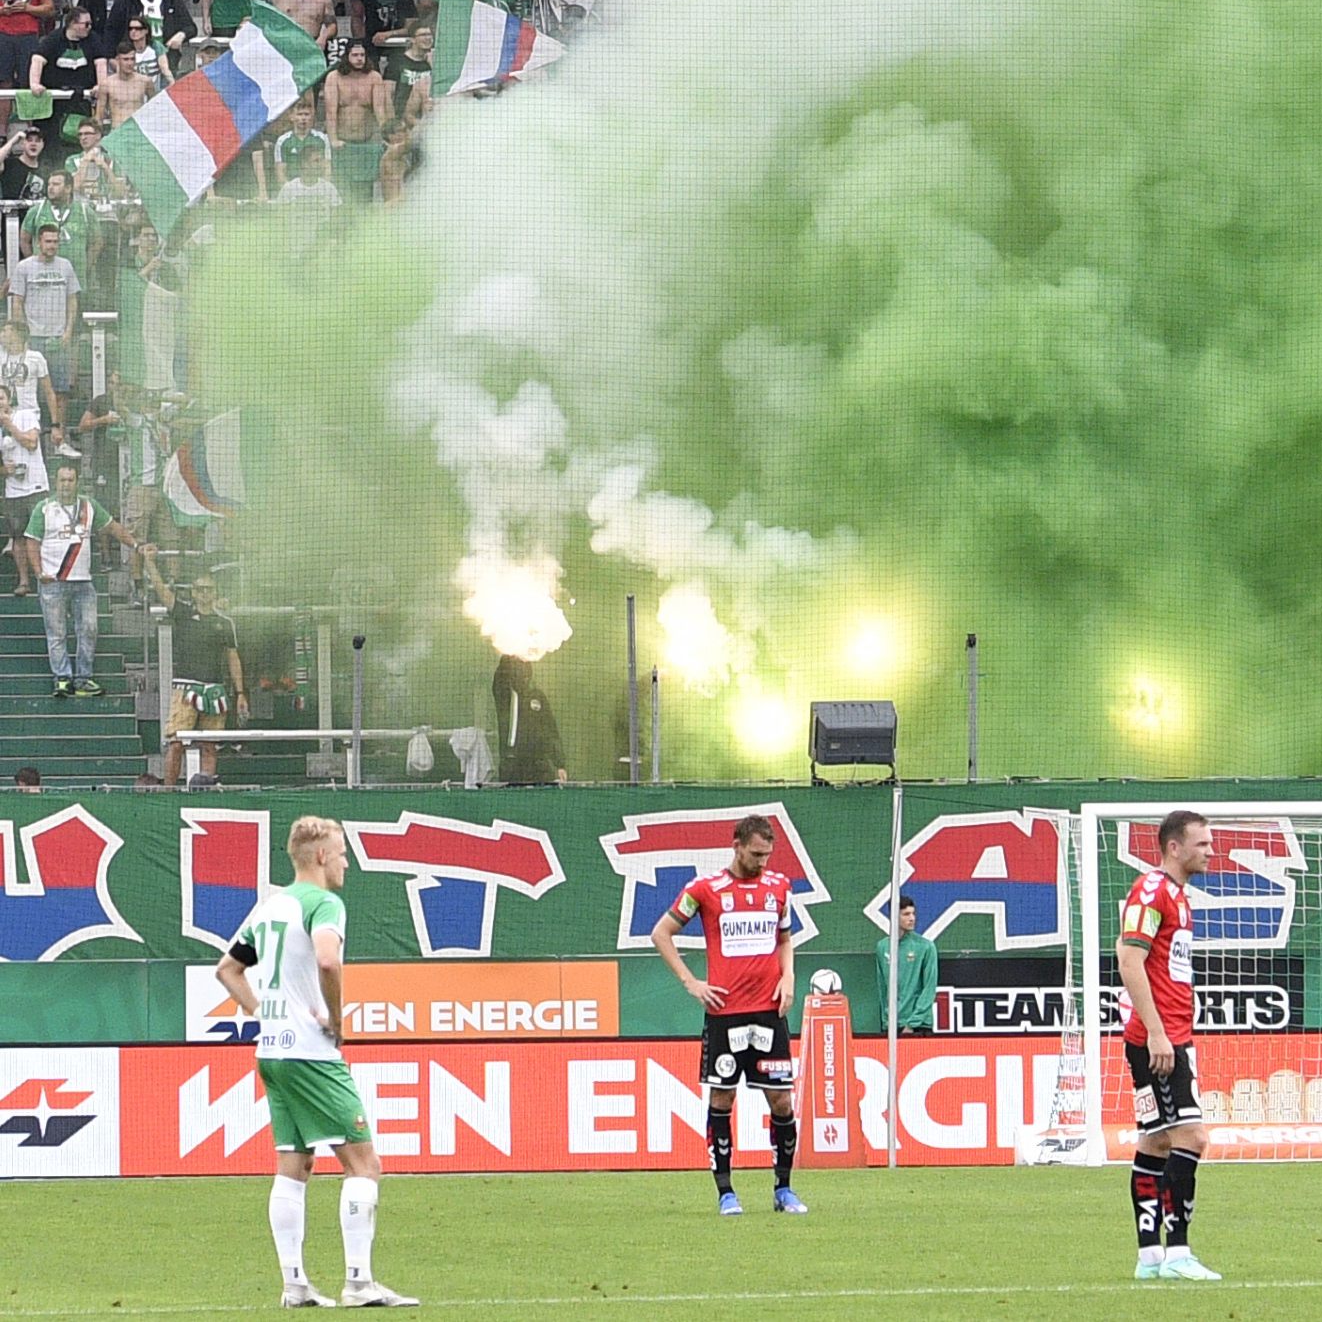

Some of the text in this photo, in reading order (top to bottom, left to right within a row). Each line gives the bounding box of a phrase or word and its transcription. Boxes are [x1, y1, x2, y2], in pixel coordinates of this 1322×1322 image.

[342, 1000, 415, 1033] IEN
[430, 999, 598, 1031] ENERGIE
[179, 1060, 512, 1158] WEN
